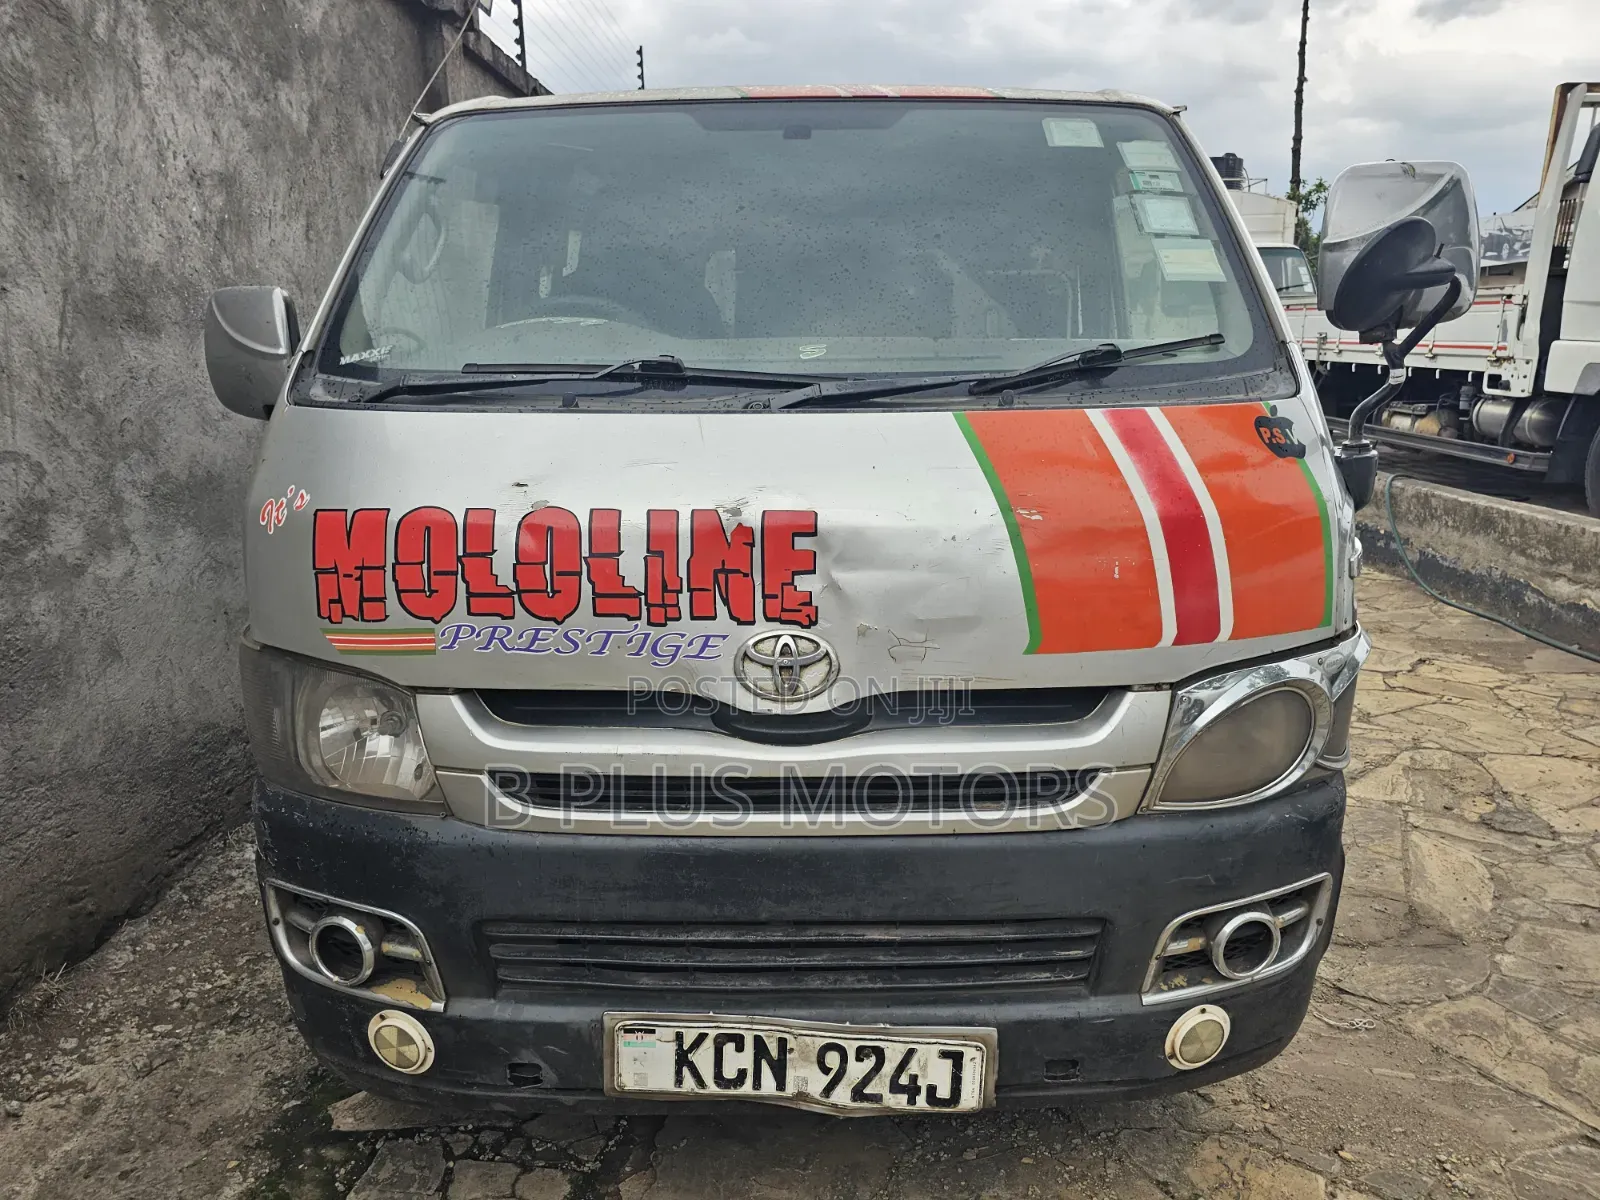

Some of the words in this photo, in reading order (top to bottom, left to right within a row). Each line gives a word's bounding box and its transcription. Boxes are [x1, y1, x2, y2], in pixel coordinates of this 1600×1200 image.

[312, 505, 819, 627] MOLOLINE
[439, 623, 730, 667] PRESTIGE
[674, 1031, 788, 1091] KCN
[815, 1042, 965, 1109] 924J
